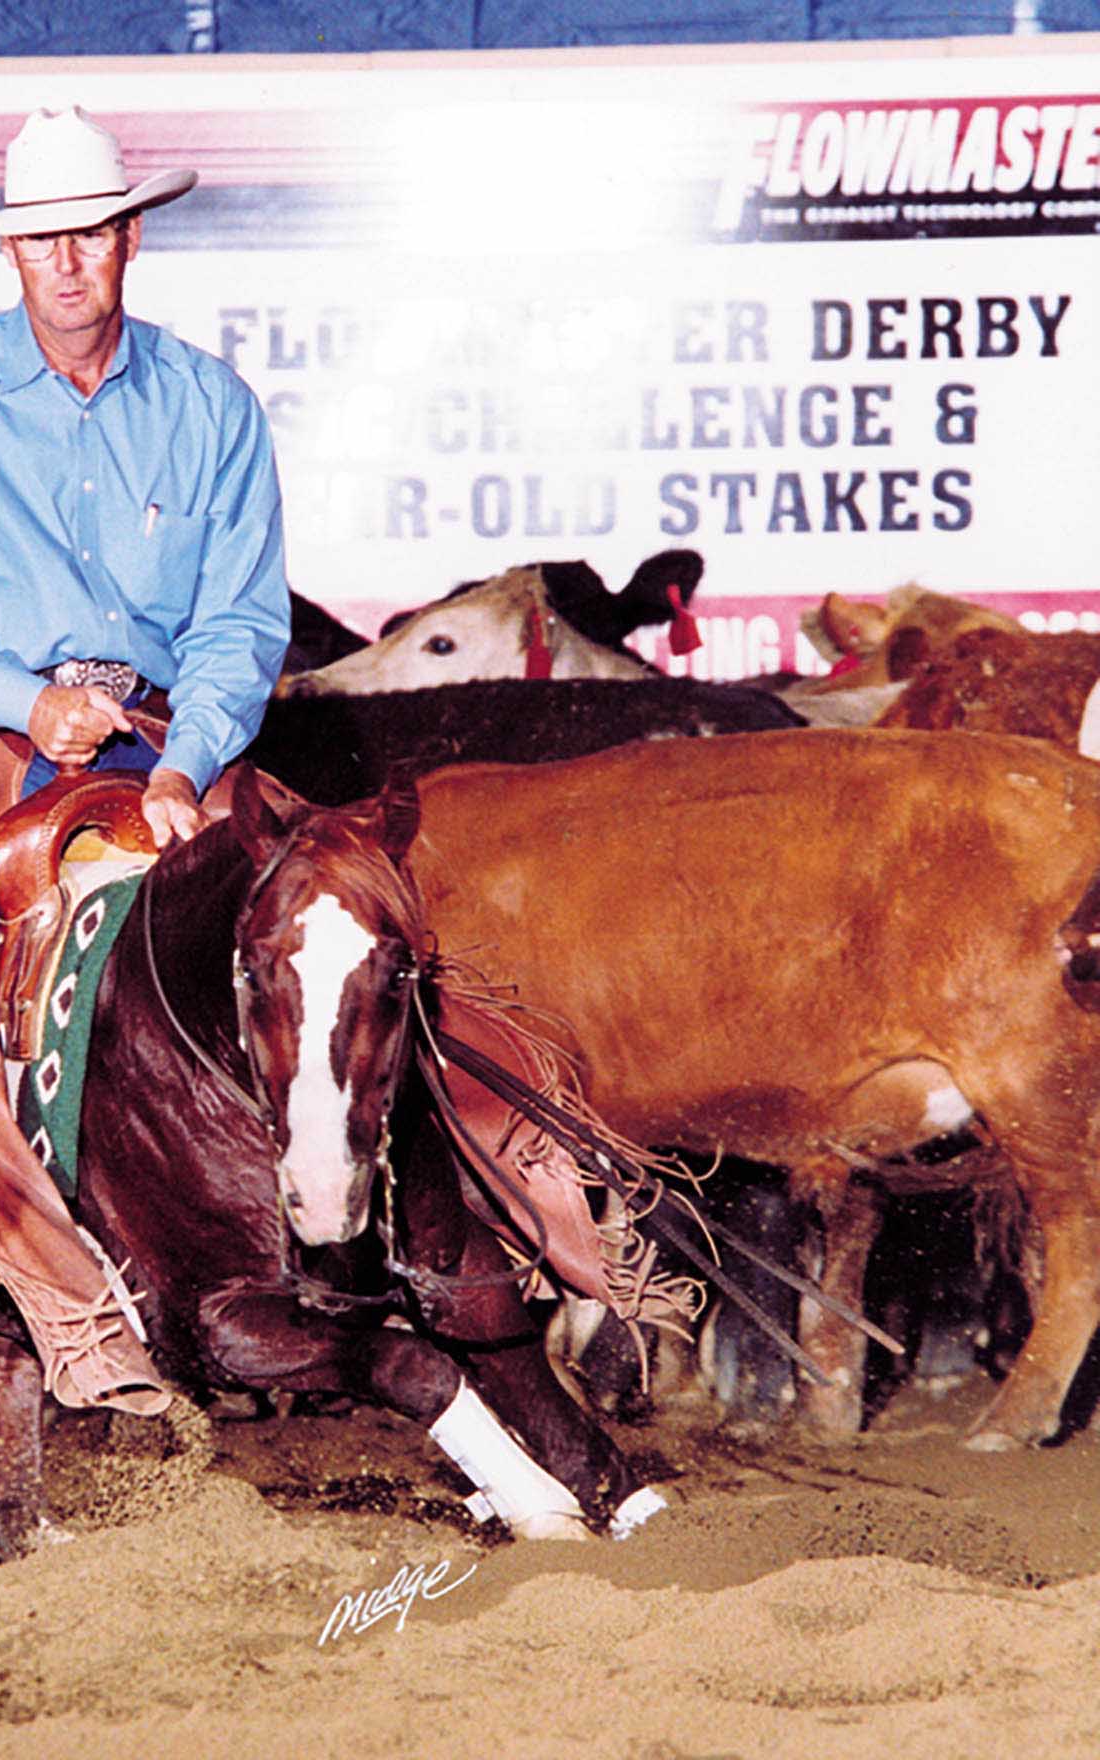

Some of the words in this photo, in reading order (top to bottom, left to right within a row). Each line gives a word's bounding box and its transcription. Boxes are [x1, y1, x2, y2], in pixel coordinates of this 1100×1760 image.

[712, 104, 1100, 232] FLOWMASTE
[811, 294, 1072, 361] DERBY
[934, 382, 979, 446] &
[659, 468, 974, 537] STAKES
